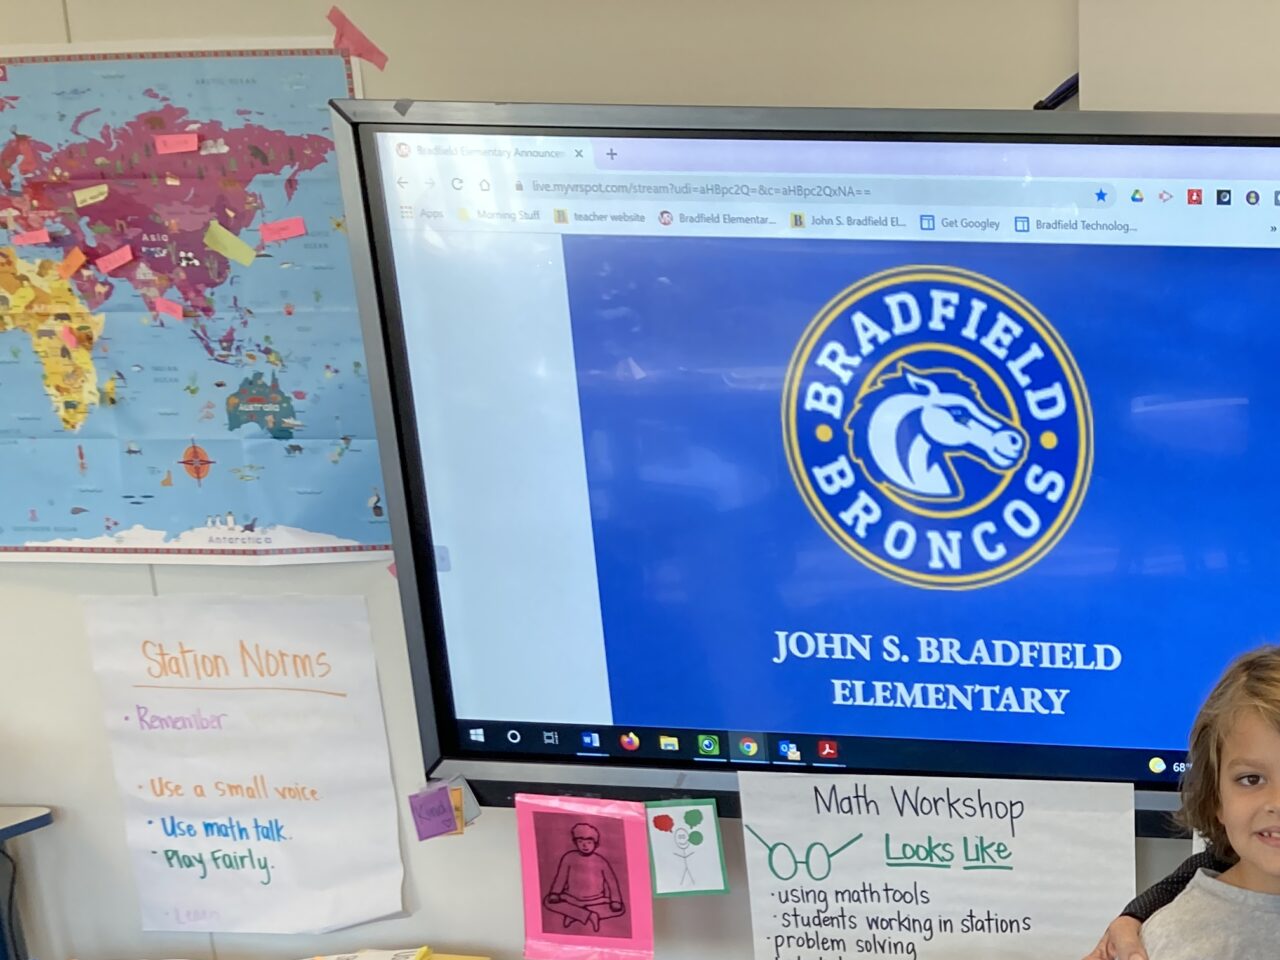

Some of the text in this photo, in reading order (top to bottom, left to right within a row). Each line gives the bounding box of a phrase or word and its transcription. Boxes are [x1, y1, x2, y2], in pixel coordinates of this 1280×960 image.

[477, 209, 517, 222] Morning
[574, 212, 646, 223] teacher website
[679, 213, 721, 224] Bradfield
[811, 216, 834, 227] John
[847, 216, 884, 227] Bradfield
[941, 218, 1001, 232] Get Googley
[1036, 219, 1078, 231] Bradfield
[804, 288, 1067, 421] BRADFIELD
[812, 454, 1066, 570] BRONCOS
[208, 535, 273, 545] Antarctica
[140, 638, 332, 680] Station Norms
[772, 630, 1122, 672] JOHN S. BRADFIELD
[830, 678, 1071, 716] ELEMENTARY
[135, 704, 229, 731] Remember
[149, 776, 185, 798] Use
[194, 785, 207, 799] a
[215, 774, 268, 799] small
[415, 797, 447, 822] Kind
[813, 783, 1025, 838] Math Workshop
[161, 816, 198, 839] Use
[203, 817, 250, 842] math
[885, 833, 1013, 864] Looks Like
[164, 848, 207, 880] Play
[777, 881, 931, 913] using math tools
[781, 907, 1032, 941] students working in stations
[773, 932, 847, 959] problem
